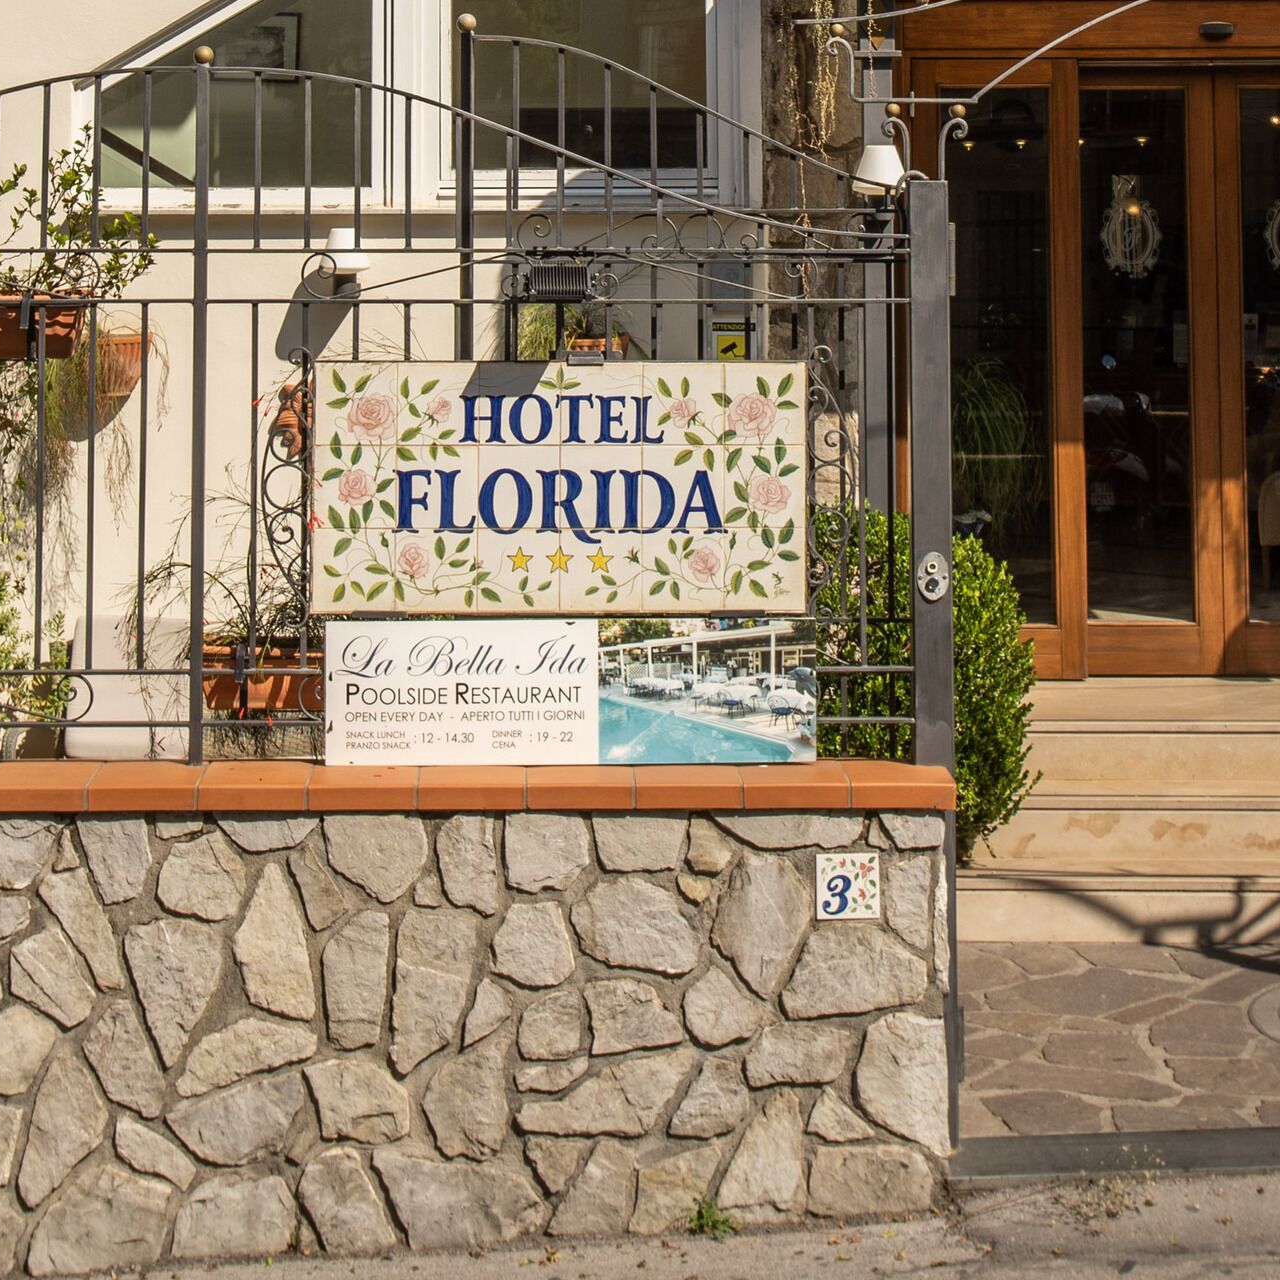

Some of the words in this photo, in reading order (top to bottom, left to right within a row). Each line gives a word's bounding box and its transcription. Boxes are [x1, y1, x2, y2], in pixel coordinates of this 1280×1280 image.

[458, 393, 664, 444] HOTEL
[392, 468, 729, 544] FLORIDA
[335, 634, 396, 679] La
[406, 635, 507, 677] Bella
[515, 634, 589, 676] Ida
[346, 683, 448, 706] POOLSIDE
[455, 682, 582, 705] RESTAURANT
[344, 711, 377, 722] OPEN
[380, 711, 416, 722] EVERY
[419, 711, 444, 722] DAY
[460, 711, 505, 722] APERTO
[508, 710, 534, 721] TUTTI
[543, 710, 585, 721] GIORNI
[346, 731, 375, 739] SNACK
[377, 731, 406, 739] LUNCH
[421, 732, 434, 744] 12
[445, 732, 475, 744] 14.30
[492, 730, 523, 738] DINNER
[537, 731, 549, 743] 19
[560, 731, 574, 742] 22
[346, 741, 380, 750] PRANZO
[382, 741, 411, 750] SNACK
[492, 741, 517, 749] CENA
[822, 874, 852, 915] 3
